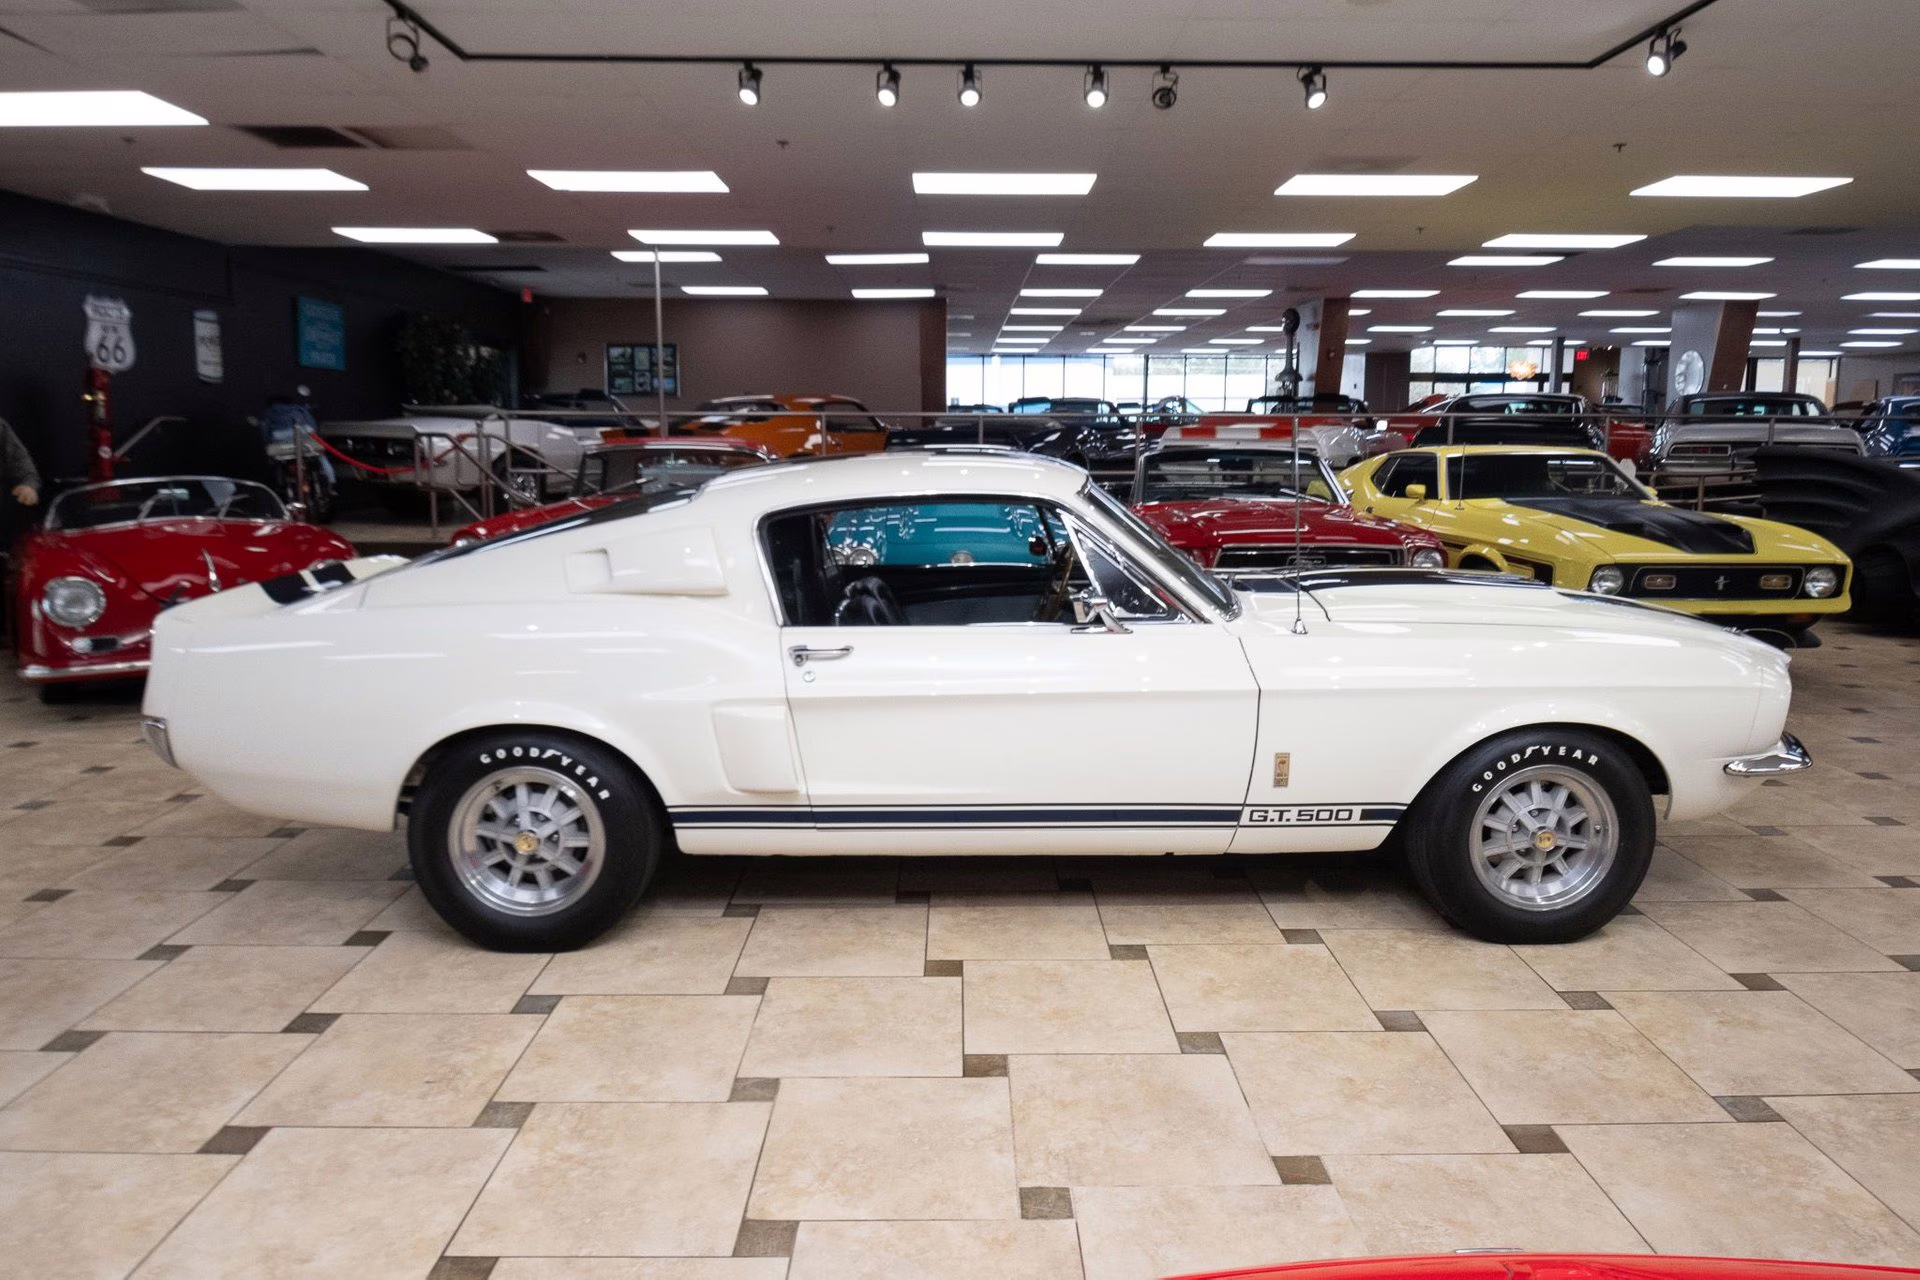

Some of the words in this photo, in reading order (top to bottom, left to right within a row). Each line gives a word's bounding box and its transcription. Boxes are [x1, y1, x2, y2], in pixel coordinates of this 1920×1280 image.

[97, 336, 127, 364] 66
[480, 747, 610, 800] GOODYEAR
[1472, 745, 1599, 792] GOODYEAR
